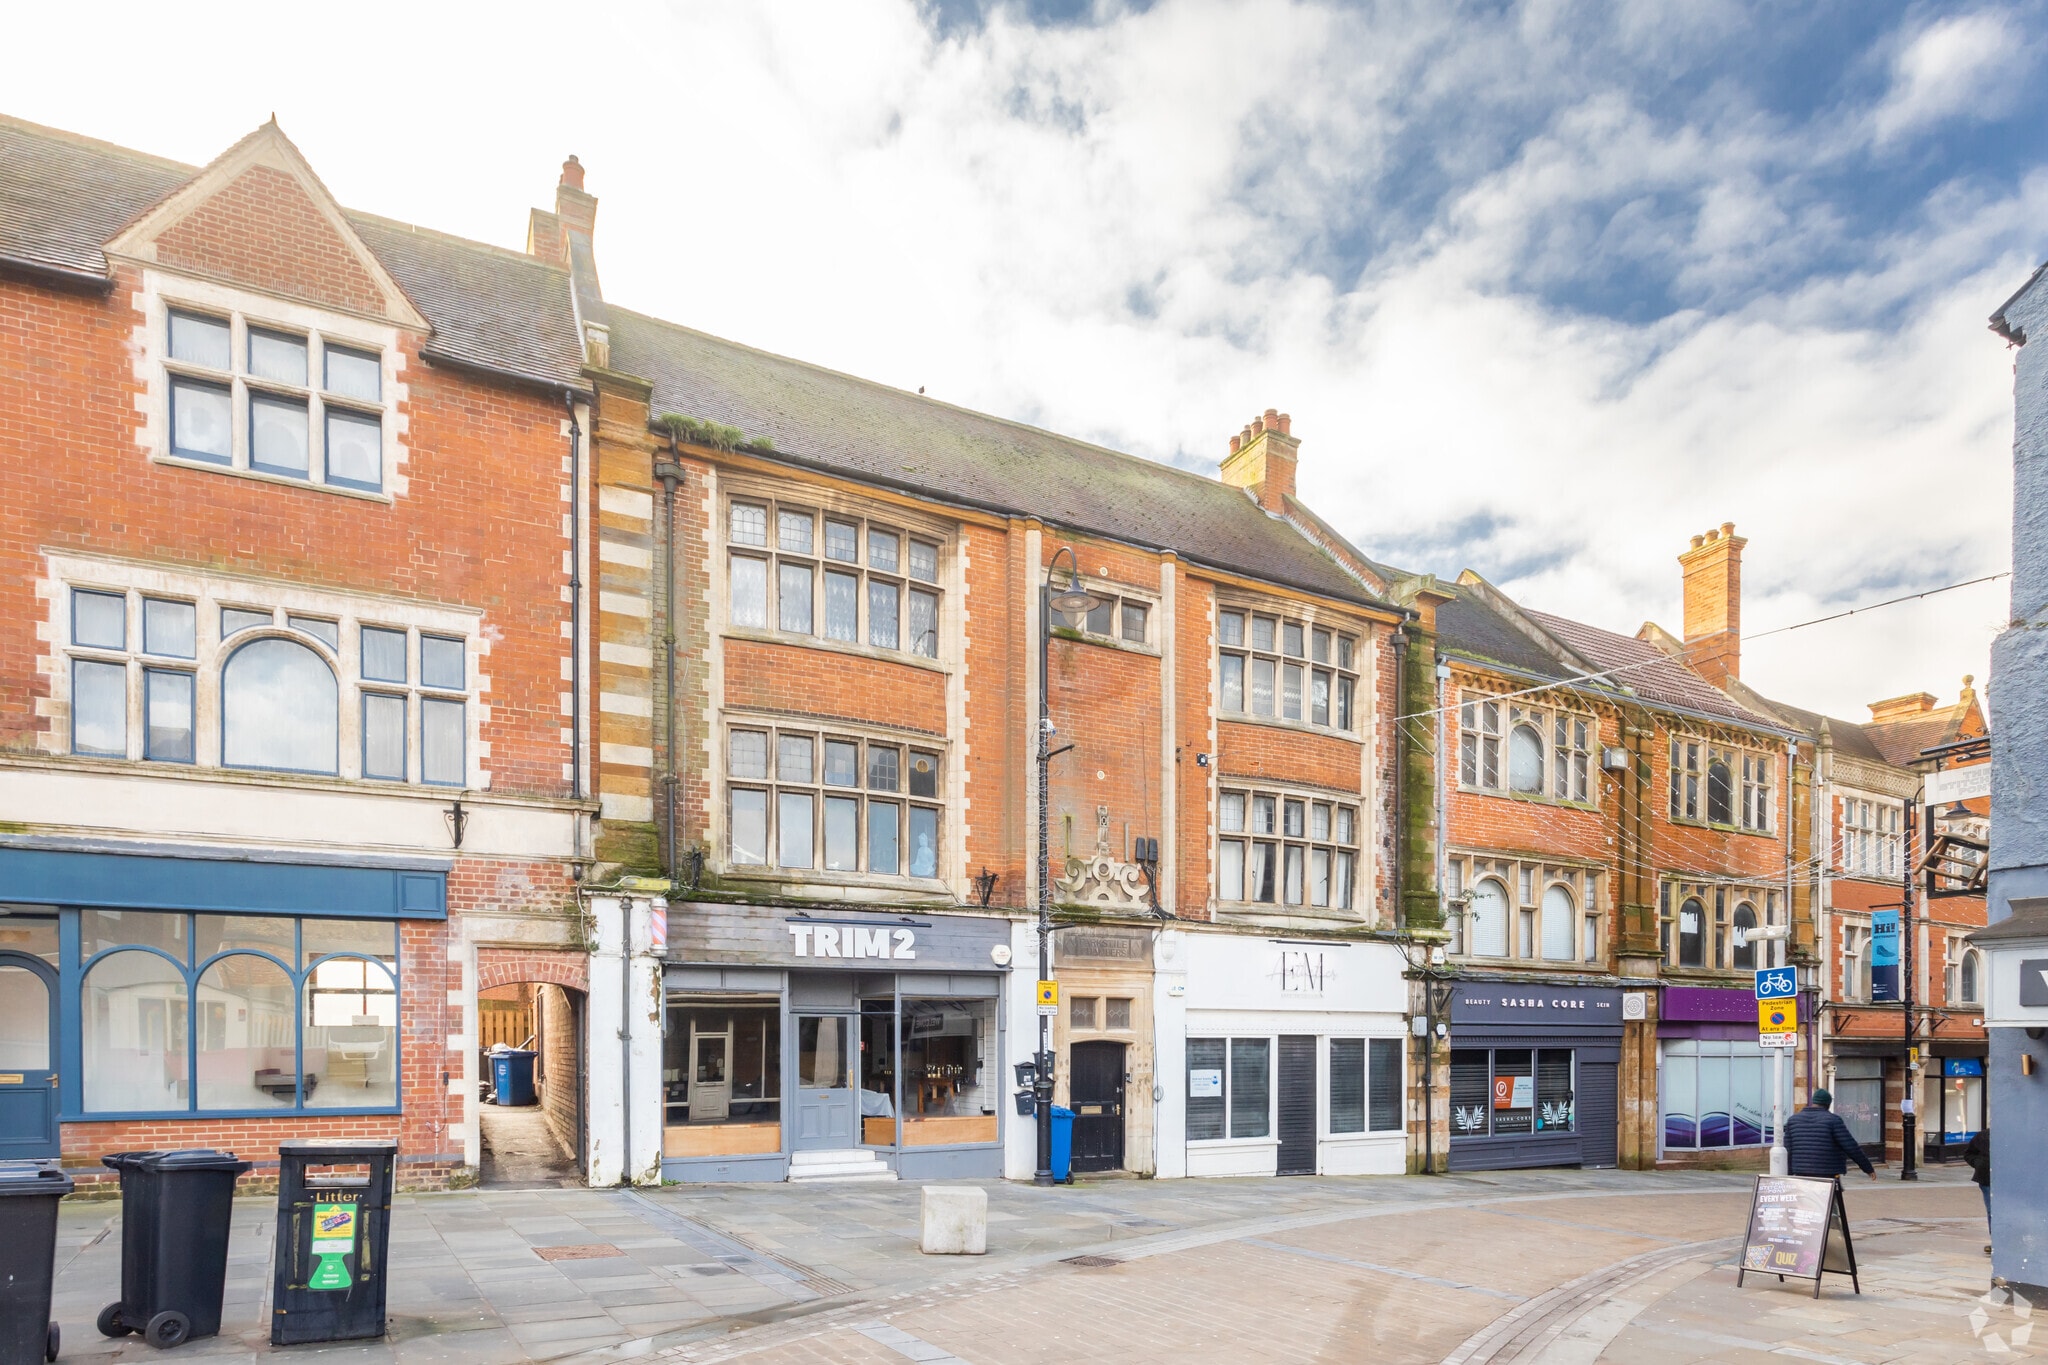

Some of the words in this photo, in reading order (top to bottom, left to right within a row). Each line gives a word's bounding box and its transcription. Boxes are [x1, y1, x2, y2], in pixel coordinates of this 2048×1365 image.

[1958, 784, 1990, 795] PON
[1874, 922, 1896, 934] Hi!
[789, 926, 916, 959] TRIM2
[1501, 998, 1544, 1008] SASHA
[1552, 999, 1585, 1009] CORE
[316, 1192, 358, 1202] Litter
[1760, 1195, 1779, 1203] EVERY
[1780, 1194, 1798, 1202] WEEK
[1775, 1251, 1797, 1265] QUIZ
